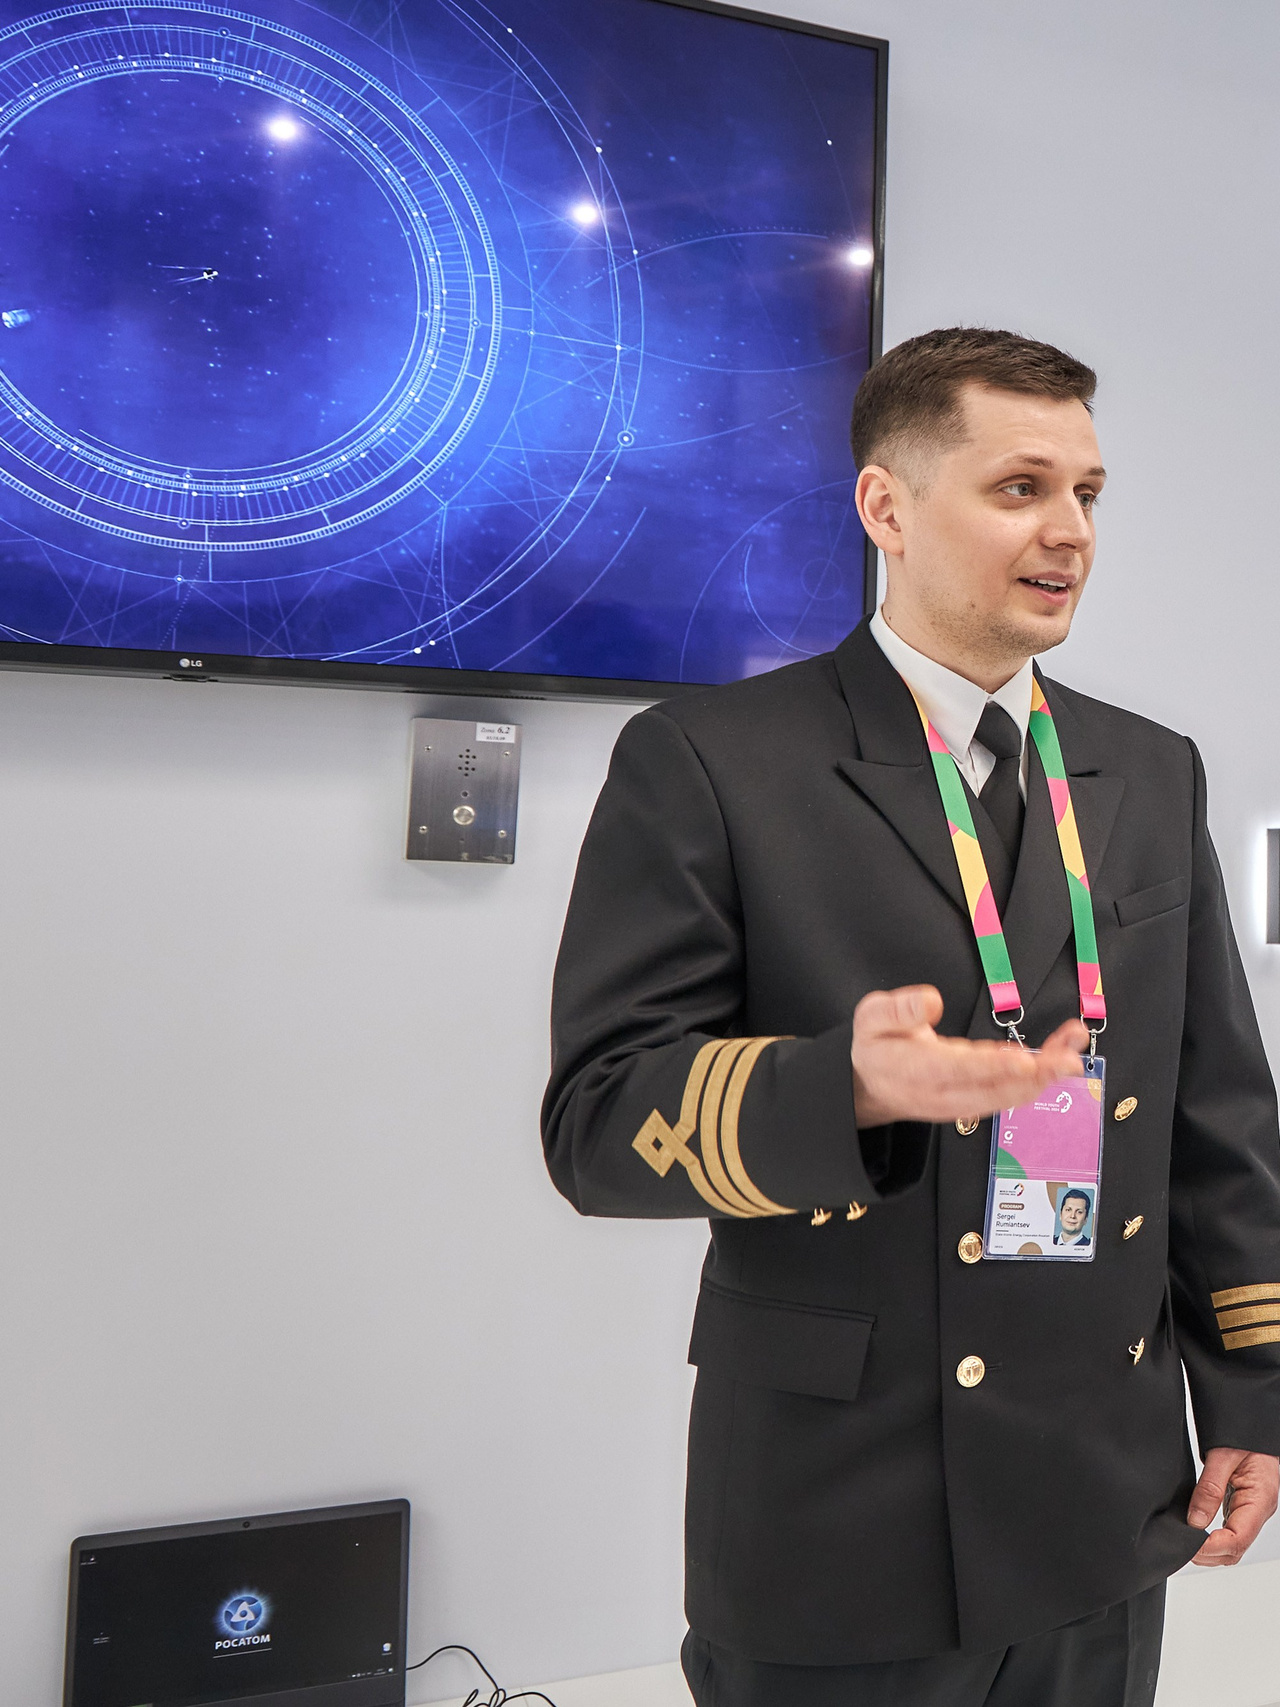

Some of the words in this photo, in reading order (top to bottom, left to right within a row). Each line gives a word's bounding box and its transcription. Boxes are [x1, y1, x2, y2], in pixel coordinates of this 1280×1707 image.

[497, 726, 510, 734] 6.2
[996, 1220, 1031, 1228] Rumiantsev
[215, 1634, 271, 1650] РОСАТОМ
